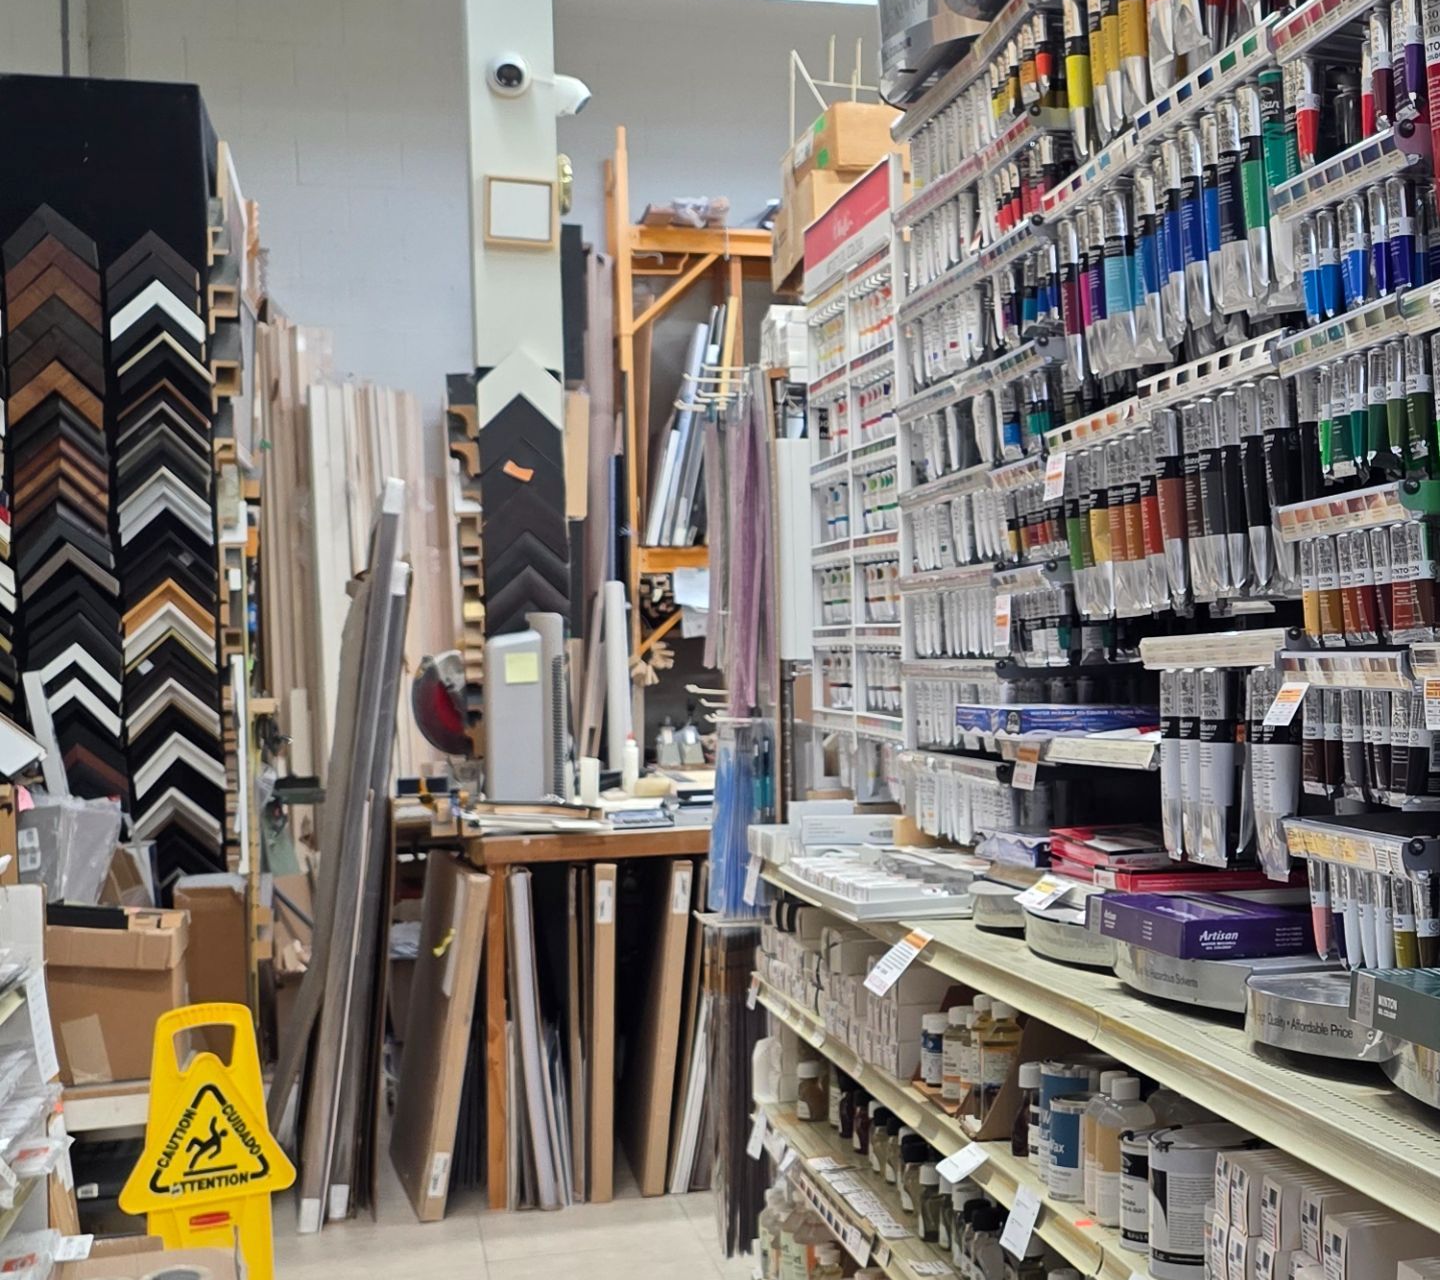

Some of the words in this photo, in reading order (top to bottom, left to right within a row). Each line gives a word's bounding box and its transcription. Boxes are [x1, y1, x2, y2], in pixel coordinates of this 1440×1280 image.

[1200, 929, 1239, 942] Artisan
[1291, 1017, 1329, 1035] Affordable
[1330, 1023, 1354, 1040] Price
[156, 1107, 198, 1169] CAUTION
[221, 1103, 261, 1157] CUIDADO
[171, 1172, 249, 1195] ATTENTION
